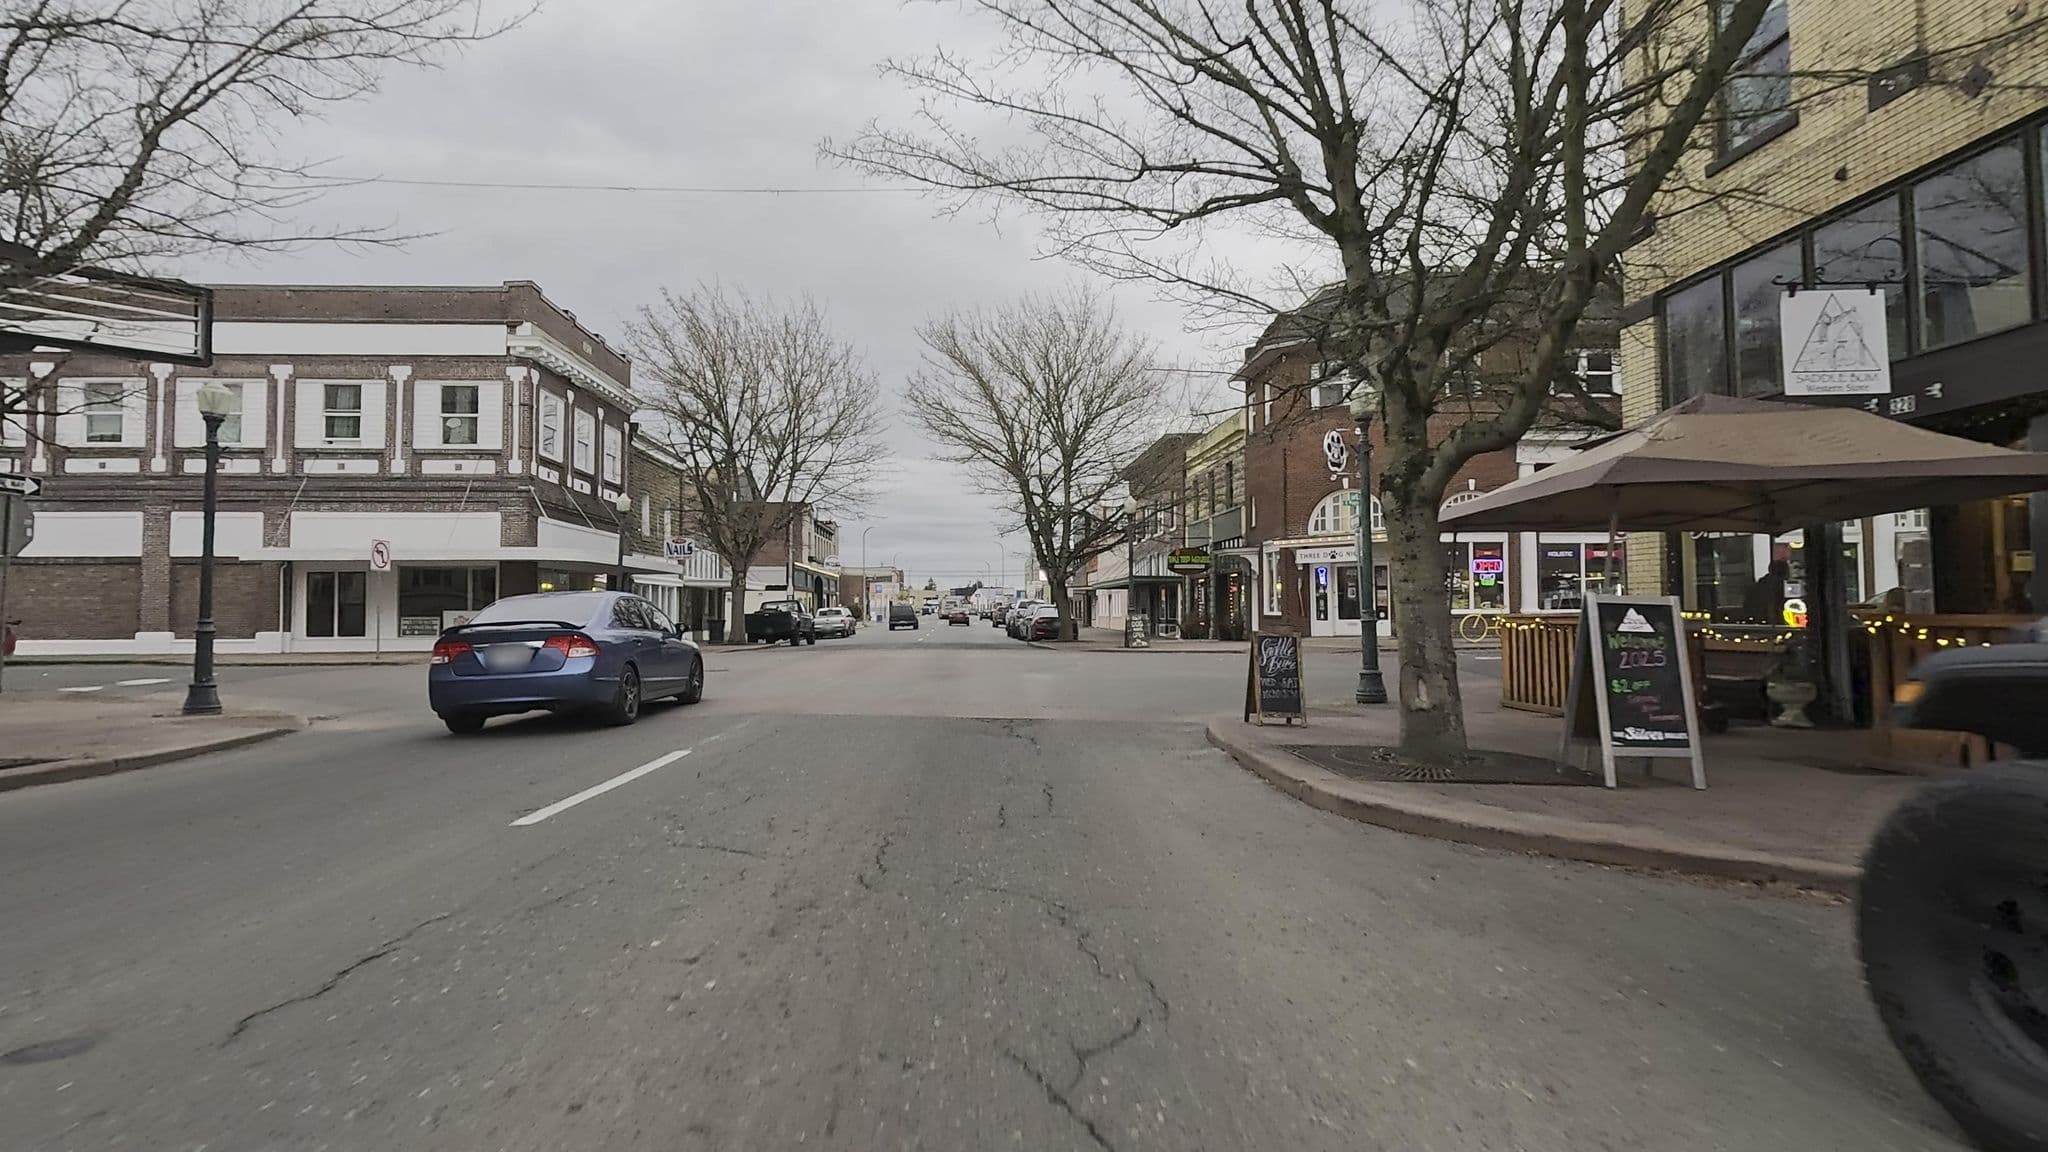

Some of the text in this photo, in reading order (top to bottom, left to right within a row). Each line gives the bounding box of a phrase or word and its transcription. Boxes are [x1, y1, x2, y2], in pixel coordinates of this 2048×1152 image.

[666, 541, 693, 555] NAILS
[1323, 550, 1344, 559] DG
[1475, 561, 1501, 571] OPEN
[1619, 651, 1667, 669] 2025
[1611, 678, 1632, 693] $2
